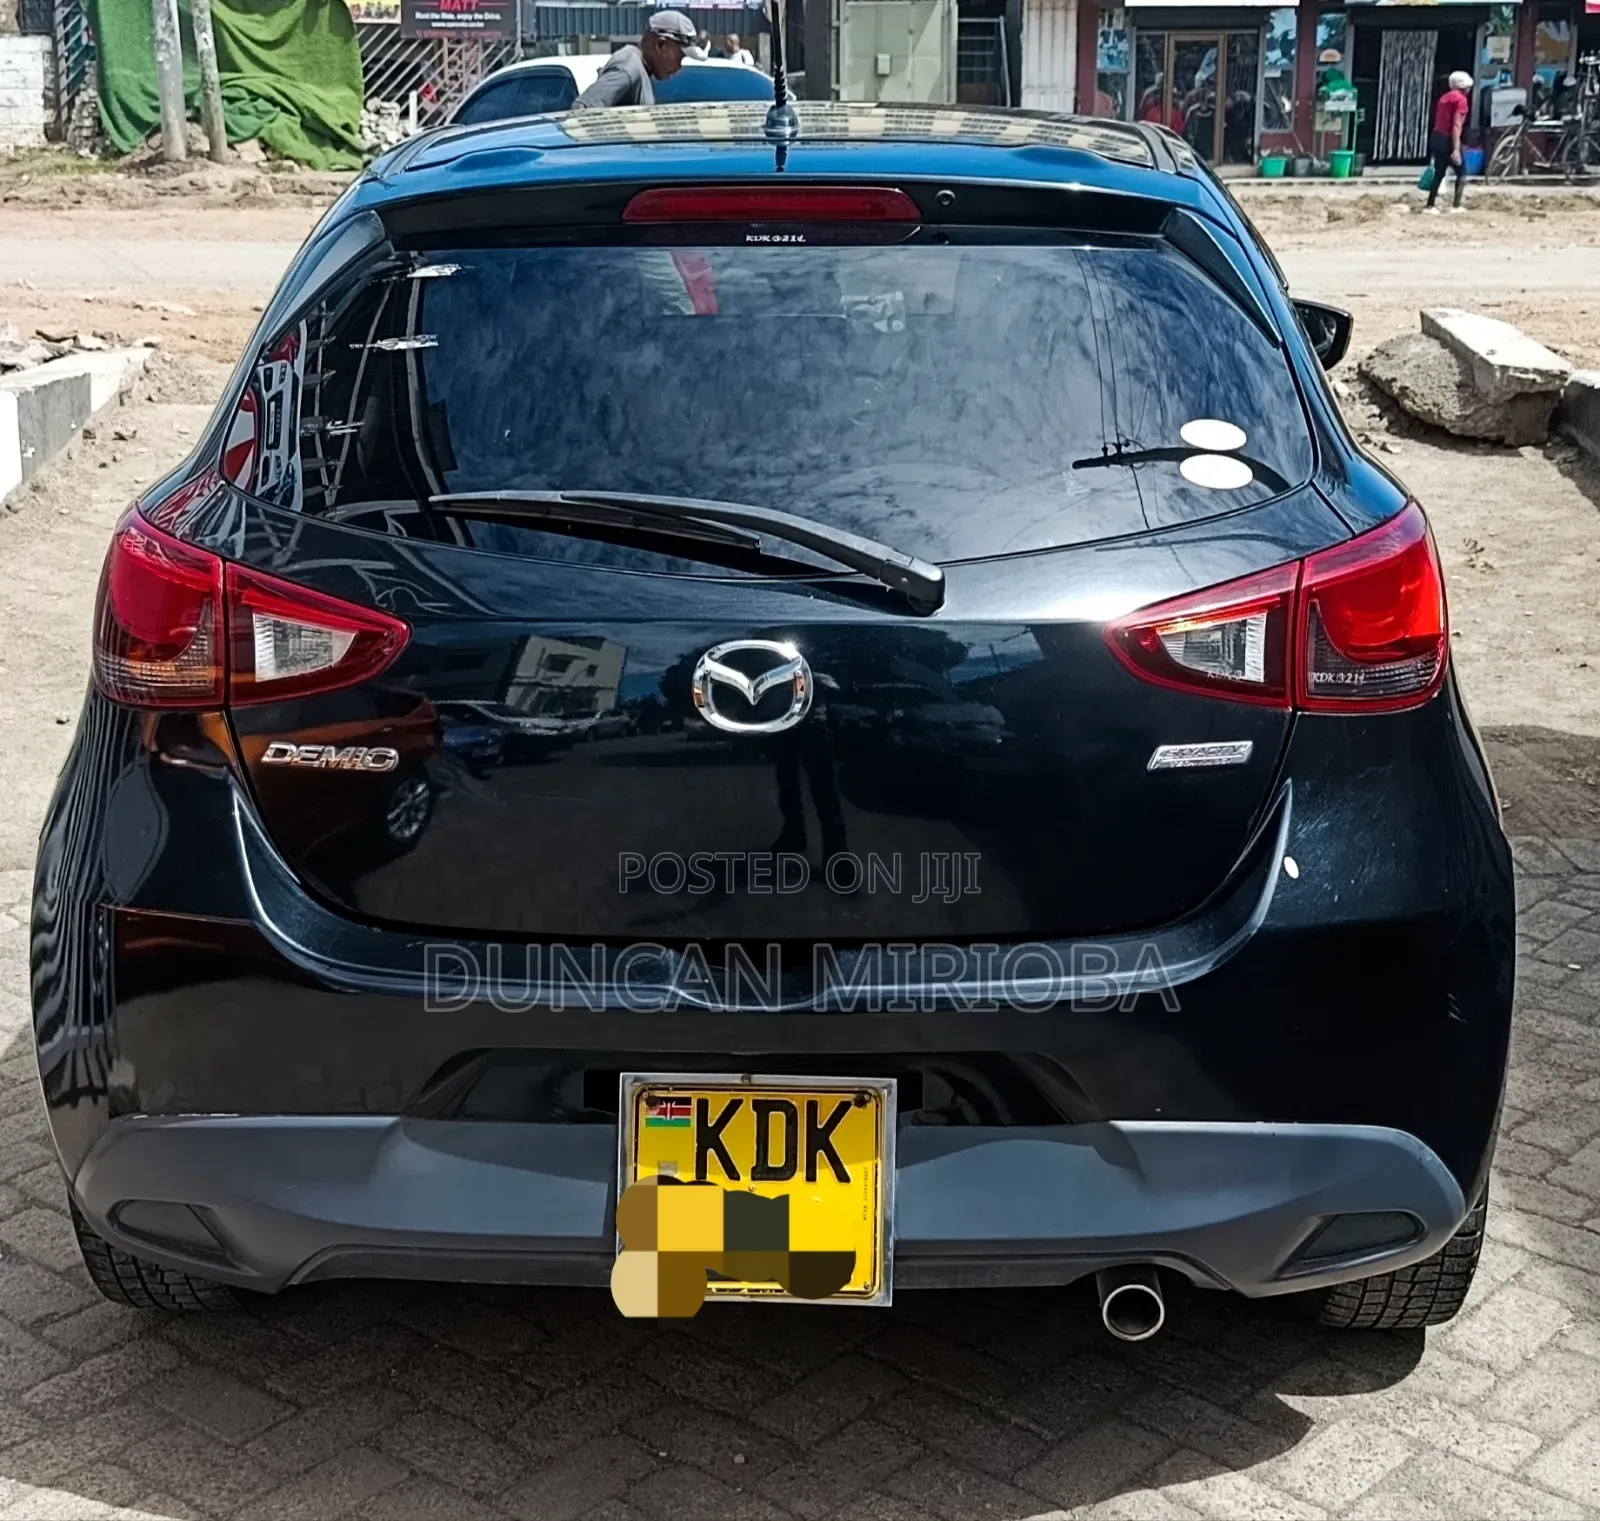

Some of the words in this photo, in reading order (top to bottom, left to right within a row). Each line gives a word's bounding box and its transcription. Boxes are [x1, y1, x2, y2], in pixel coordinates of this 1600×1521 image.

[440, 0, 478, 10] MATT
[261, 741, 399, 771] DEMIO
[695, 1097, 854, 1184] KDK
